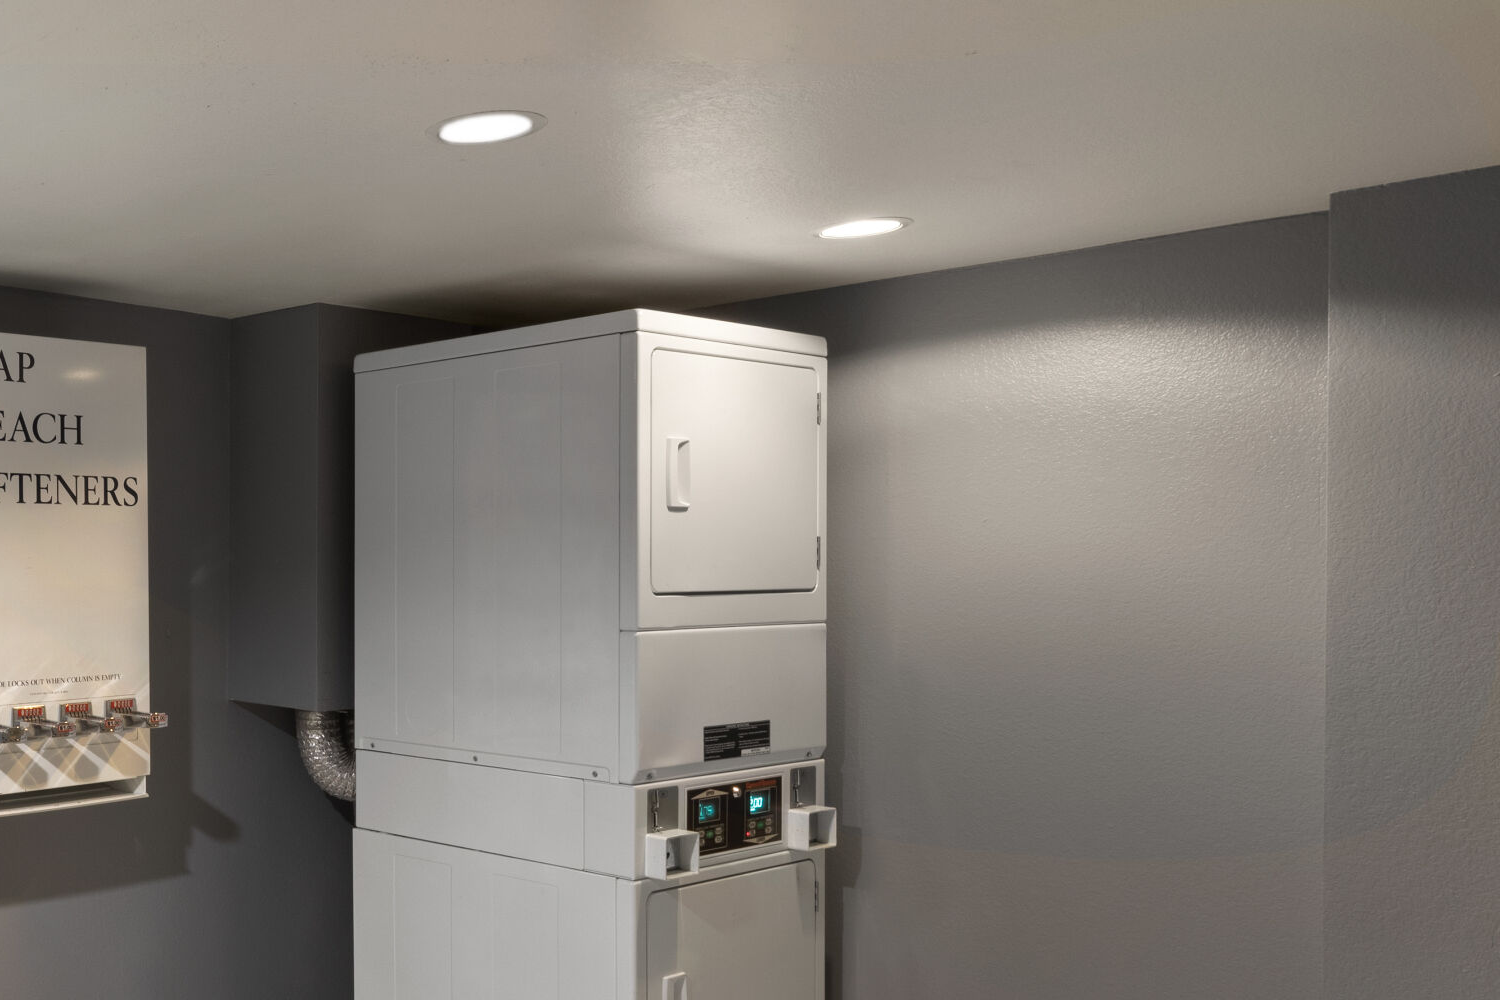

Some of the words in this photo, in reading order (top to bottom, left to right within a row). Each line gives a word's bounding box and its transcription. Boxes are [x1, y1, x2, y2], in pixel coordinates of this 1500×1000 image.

[8, 679, 29, 687] LOCKS
[46, 677, 66, 685] WHEN
[67, 675, 93, 684] COLUMN
[95, 674, 100, 682] IS
[102, 673, 122, 681] EMPTY
